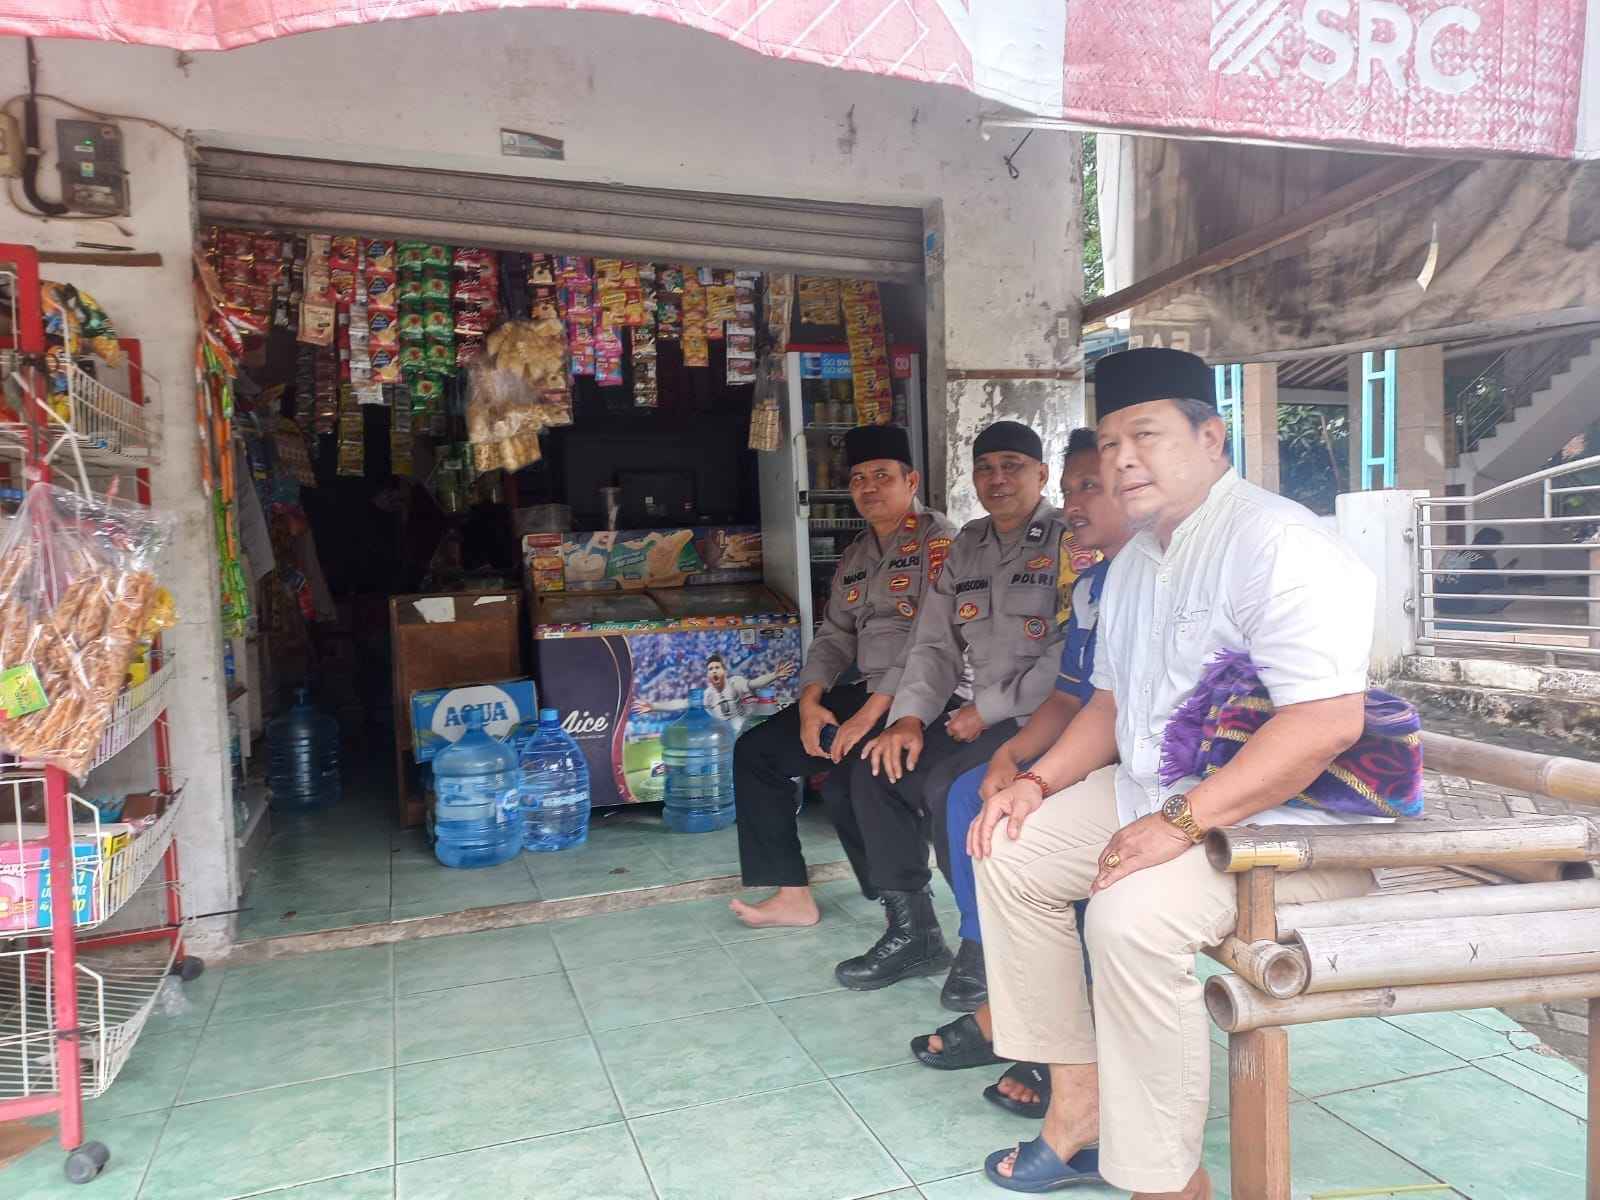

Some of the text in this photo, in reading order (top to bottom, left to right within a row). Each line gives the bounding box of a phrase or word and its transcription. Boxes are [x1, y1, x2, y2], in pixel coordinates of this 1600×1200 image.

[1300, 0, 1481, 98] SRC
[1010, 573, 1054, 586] POLRI
[444, 701, 509, 728] AQUA
[561, 709, 609, 734] Aice
